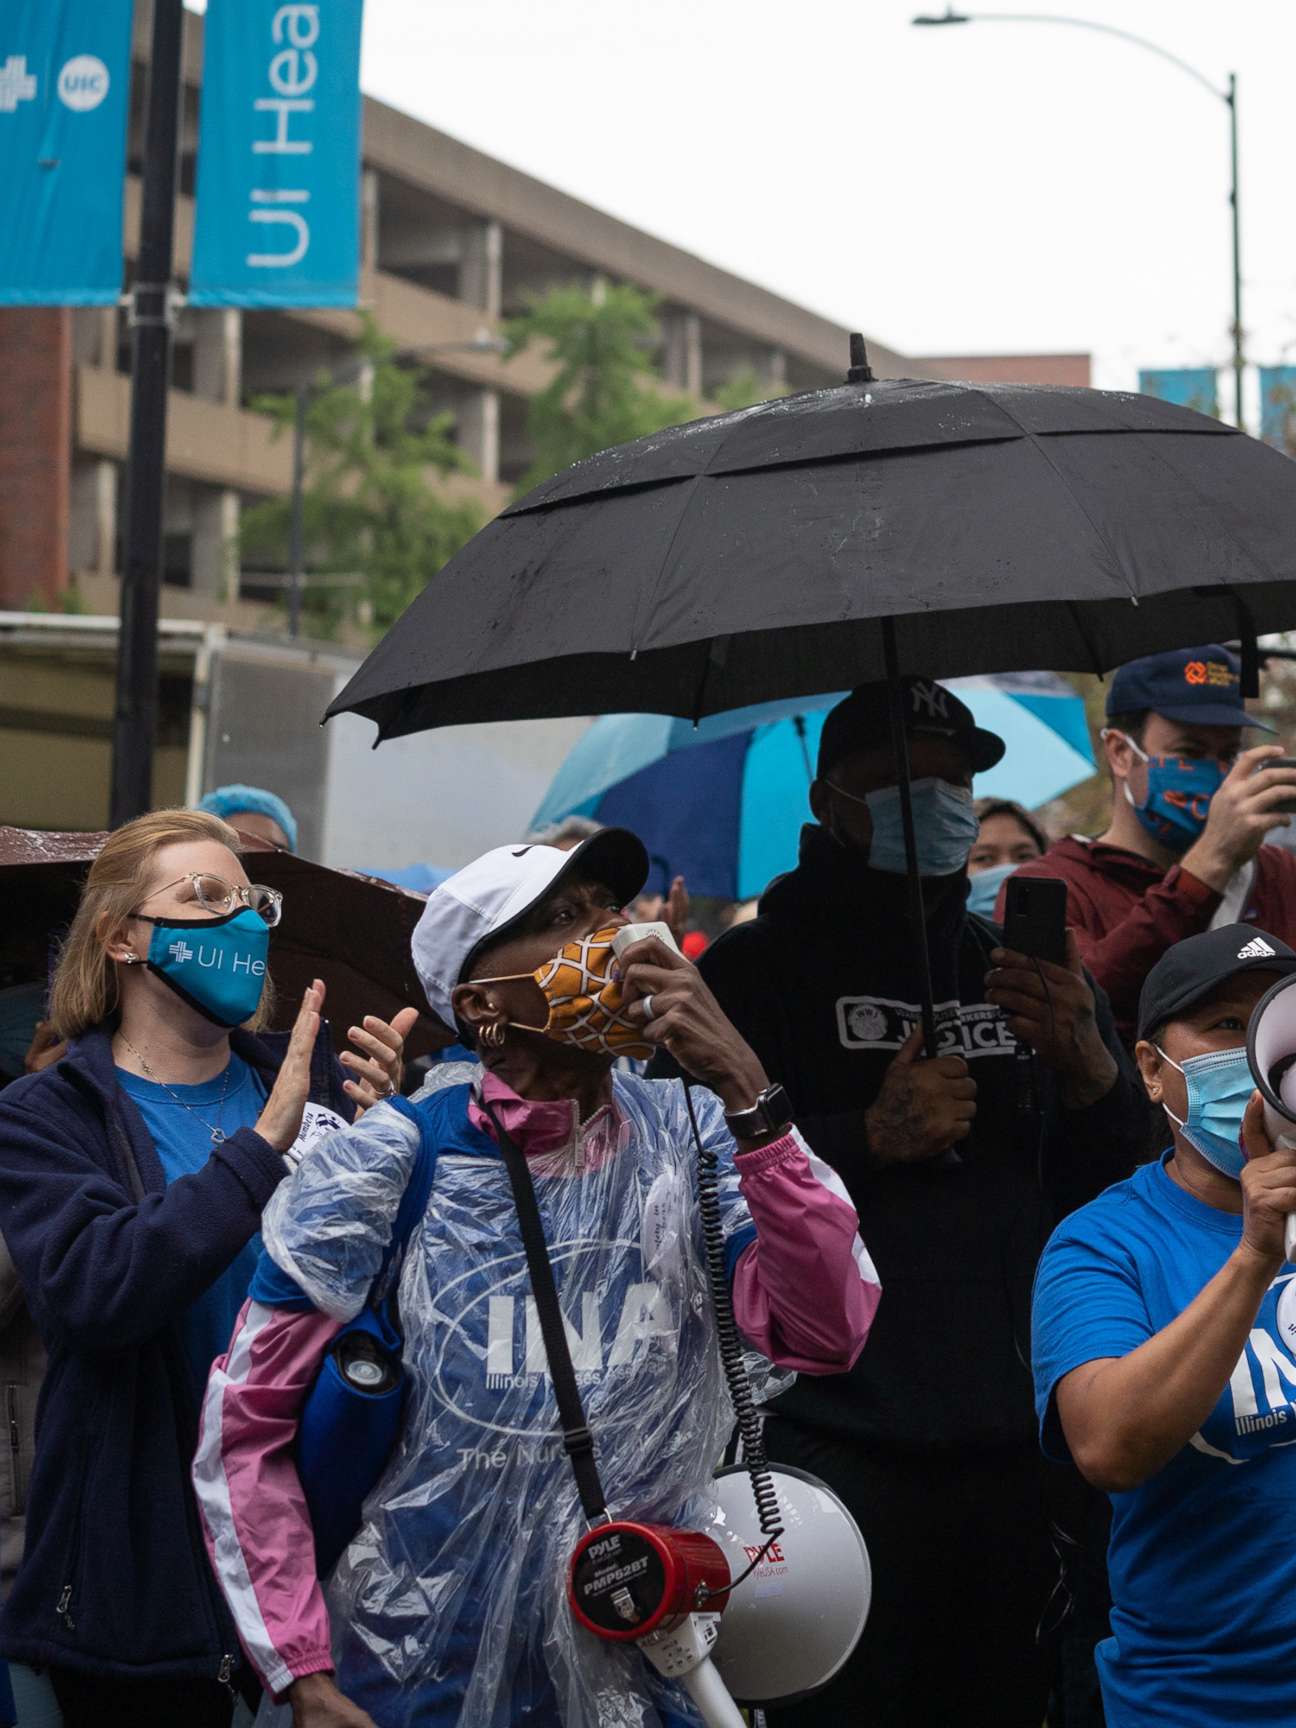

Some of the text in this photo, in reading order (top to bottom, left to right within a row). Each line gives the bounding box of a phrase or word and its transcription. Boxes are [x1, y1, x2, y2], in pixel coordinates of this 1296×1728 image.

[64, 76, 101, 93] UIC
[246, 190, 311, 267] UI
[198, 945, 224, 969] UI
[485, 1372, 538, 1390] Illinois
[1235, 1409, 1288, 1436] Illinois
[457, 1449, 507, 1471] The
[588, 1534, 622, 1560] PYLE
[583, 1556, 650, 1596] PMP52BT
